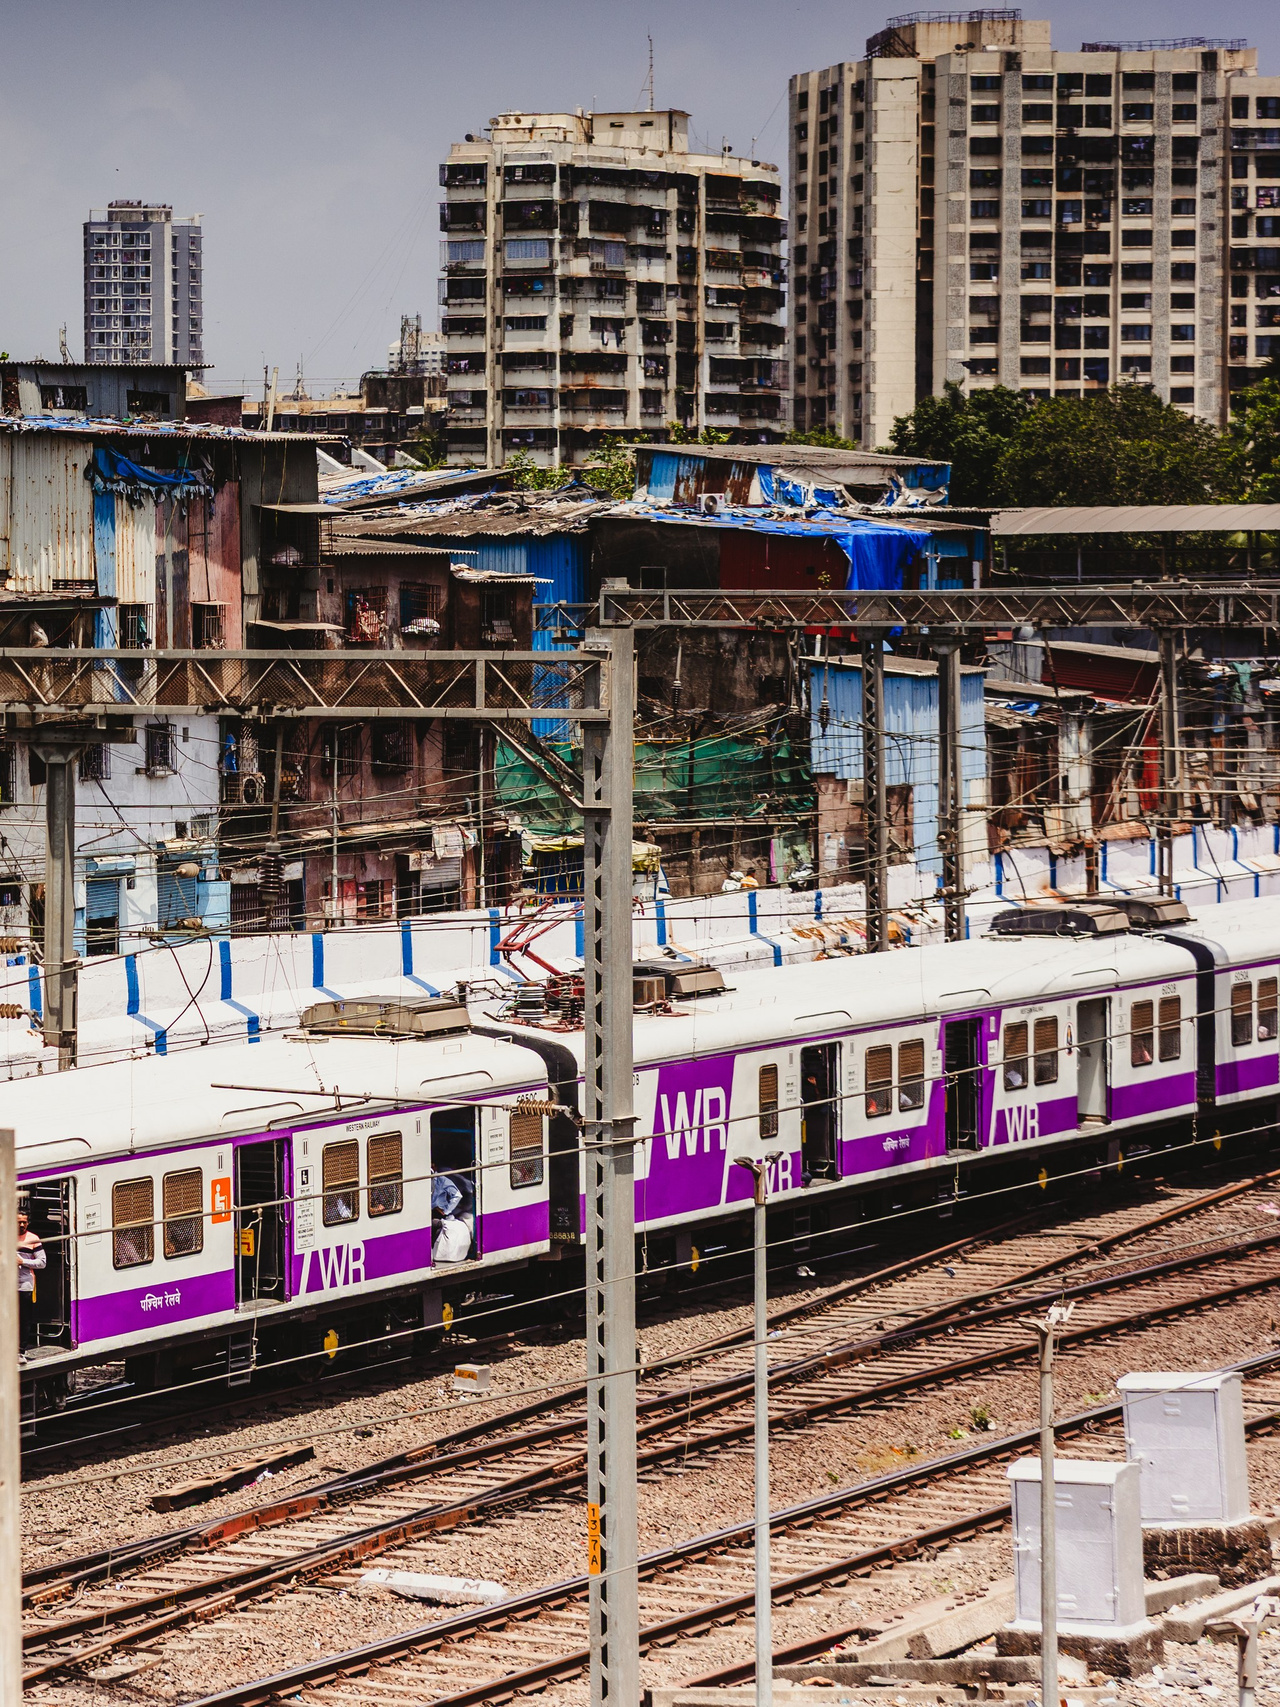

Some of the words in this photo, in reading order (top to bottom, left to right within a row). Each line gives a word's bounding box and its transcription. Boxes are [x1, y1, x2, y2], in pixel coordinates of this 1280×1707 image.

[346, 1122, 364, 1132] WESTERN
[364, 1120, 380, 1129] RAILWAY
[660, 1086, 727, 1160] WR
[1005, 1103, 1039, 1143] WR
[318, 1239, 366, 1290] WR
[140, 1293, 163, 1312] पश्चिम
[164, 1288, 181, 1307] रेलवे
